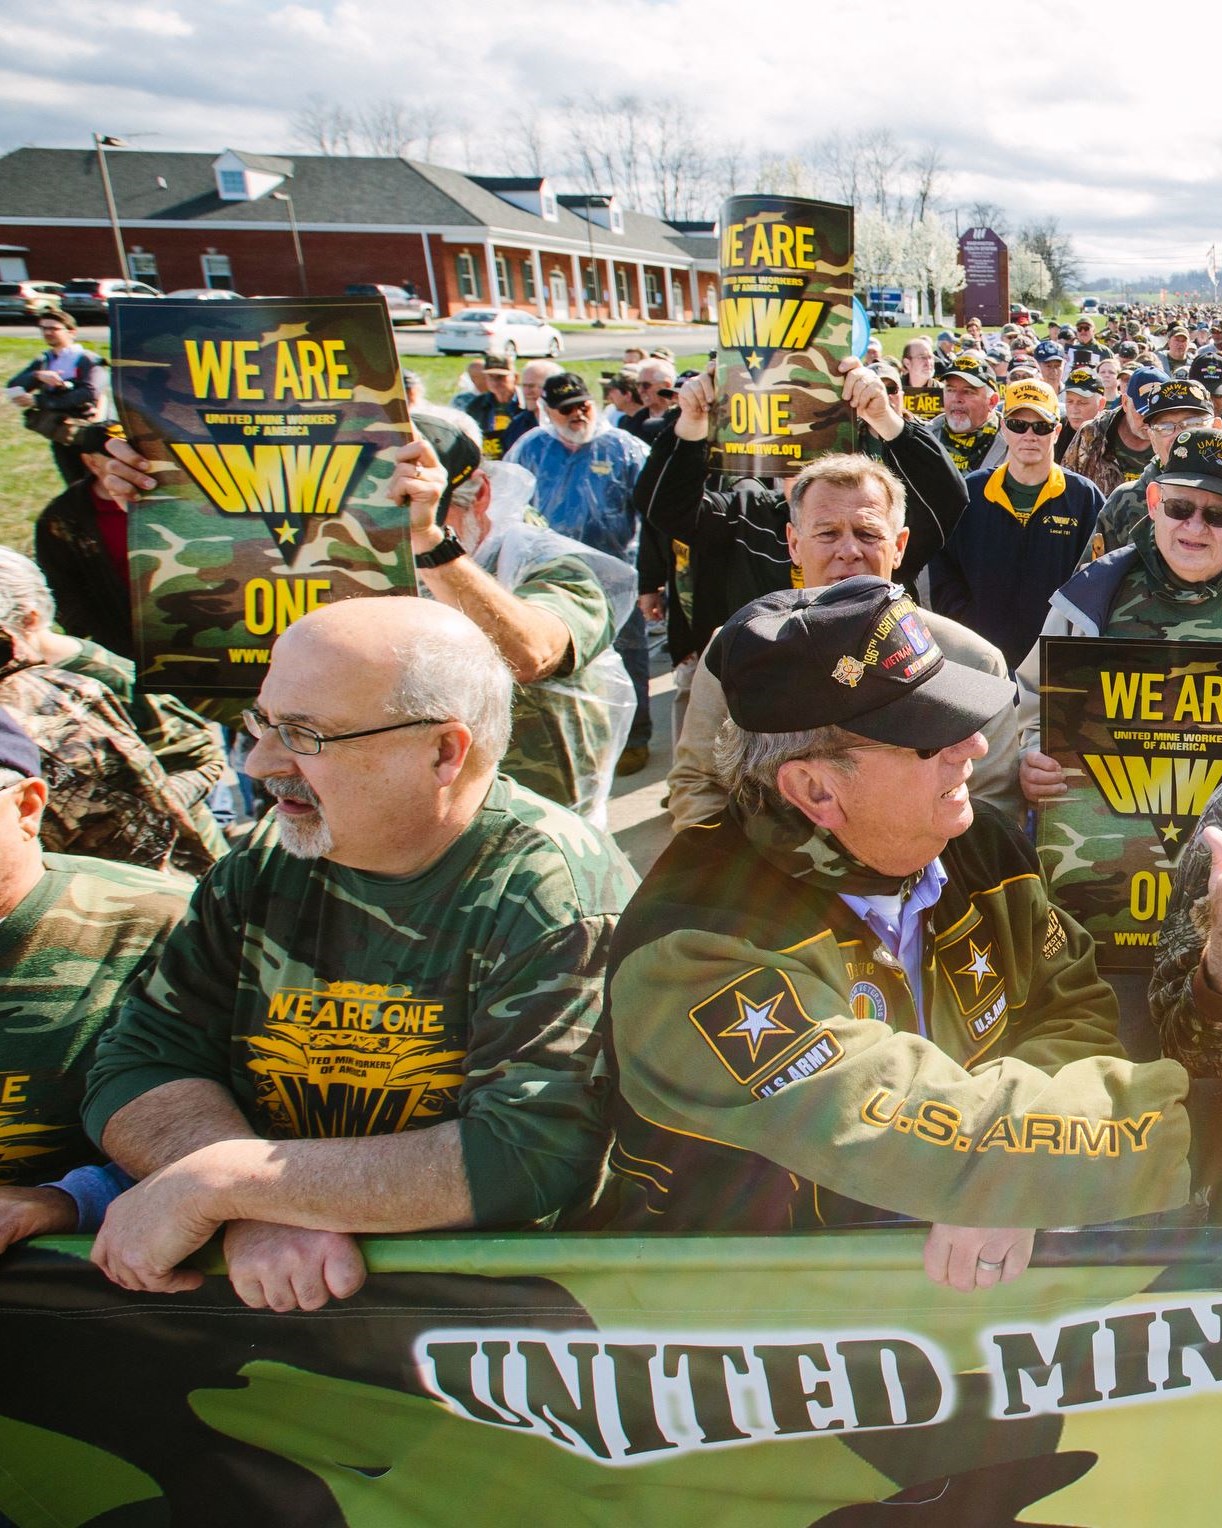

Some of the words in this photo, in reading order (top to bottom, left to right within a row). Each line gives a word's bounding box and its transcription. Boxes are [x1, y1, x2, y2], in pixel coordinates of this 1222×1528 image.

[750, 222, 817, 271] ARE
[740, 283, 780, 294] AMERICA
[757, 275, 804, 287] WORKERS
[719, 297, 825, 350] UMWA
[183, 339, 265, 400] WE
[273, 339, 353, 400] ARE
[730, 392, 792, 436] ONE
[918, 396, 940, 411] ARE
[205, 413, 252, 426] UNITED
[254, 414, 285, 426] MINE
[286, 413, 337, 426] WORKERS
[242, 425, 261, 437] OF
[261, 425, 310, 438] AMERICA
[725, 441, 802, 459] www.umwa.org
[169, 443, 366, 514] UMWA
[862, 638, 878, 666] 196TH
[874, 612, 896, 641] LIGHT
[228, 648, 272, 664] www.
[881, 643, 914, 670] VIETNAM
[1100, 671, 1166, 721] WE
[1113, 731, 1151, 742] UNITED
[1152, 732, 1182, 743] MINE
[1143, 741, 1158, 751] OF
[1158, 742, 1207, 752] AMERICA
[1130, 870, 1172, 921] ON
[1044, 940, 1063, 960] STATE
[859, 983, 884, 1018] VETERANS
[310, 1000, 378, 1031] ARE
[382, 1003, 445, 1033] ONE
[320, 1064, 334, 1075] OF
[426, 1338, 943, 1460] UNITED
